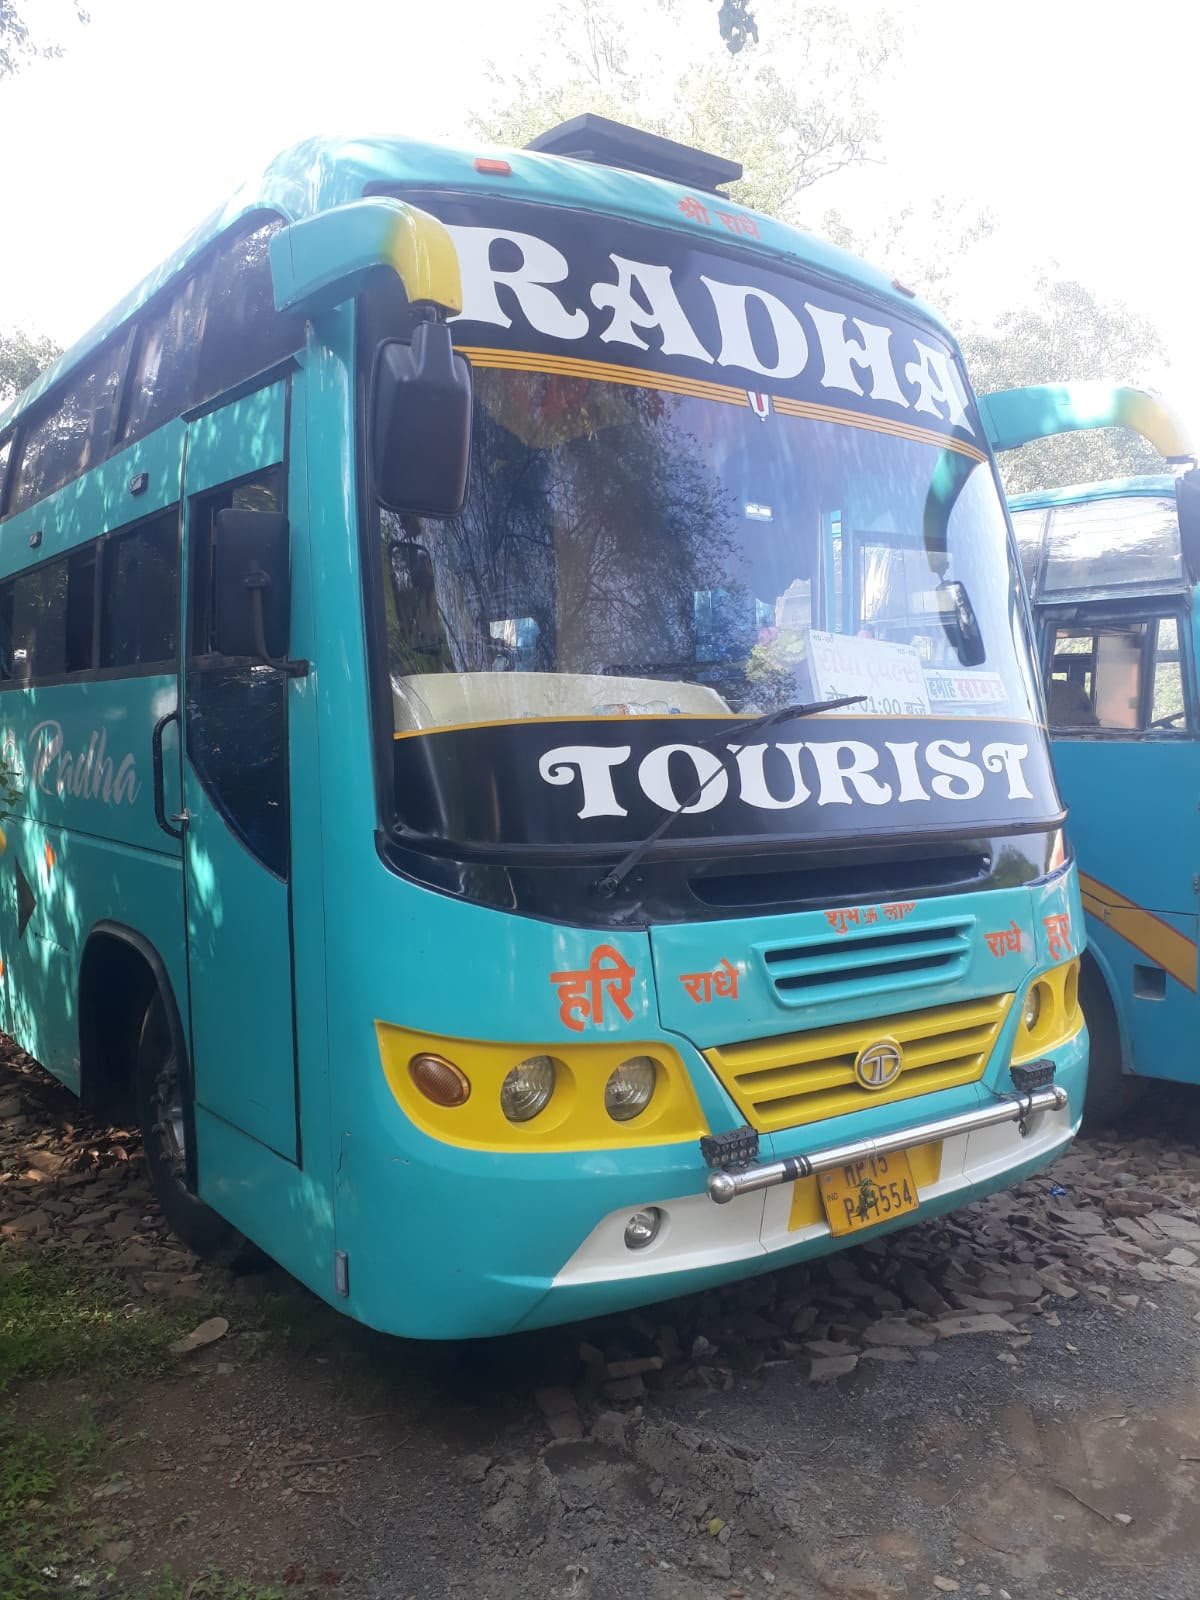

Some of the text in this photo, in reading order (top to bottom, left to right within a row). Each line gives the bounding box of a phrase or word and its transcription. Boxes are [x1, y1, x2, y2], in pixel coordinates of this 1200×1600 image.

[678, 196, 761, 241] श्री राधे
[446, 224, 976, 437] RADHA
[28, 719, 142, 805] Radha
[538, 740, 1033, 819] TOURIST
[824, 908, 860, 935] शुभ
[984, 919, 1022, 958] राधे
[549, 944, 636, 1032] हरि
[680, 958, 739, 1004] राधे
